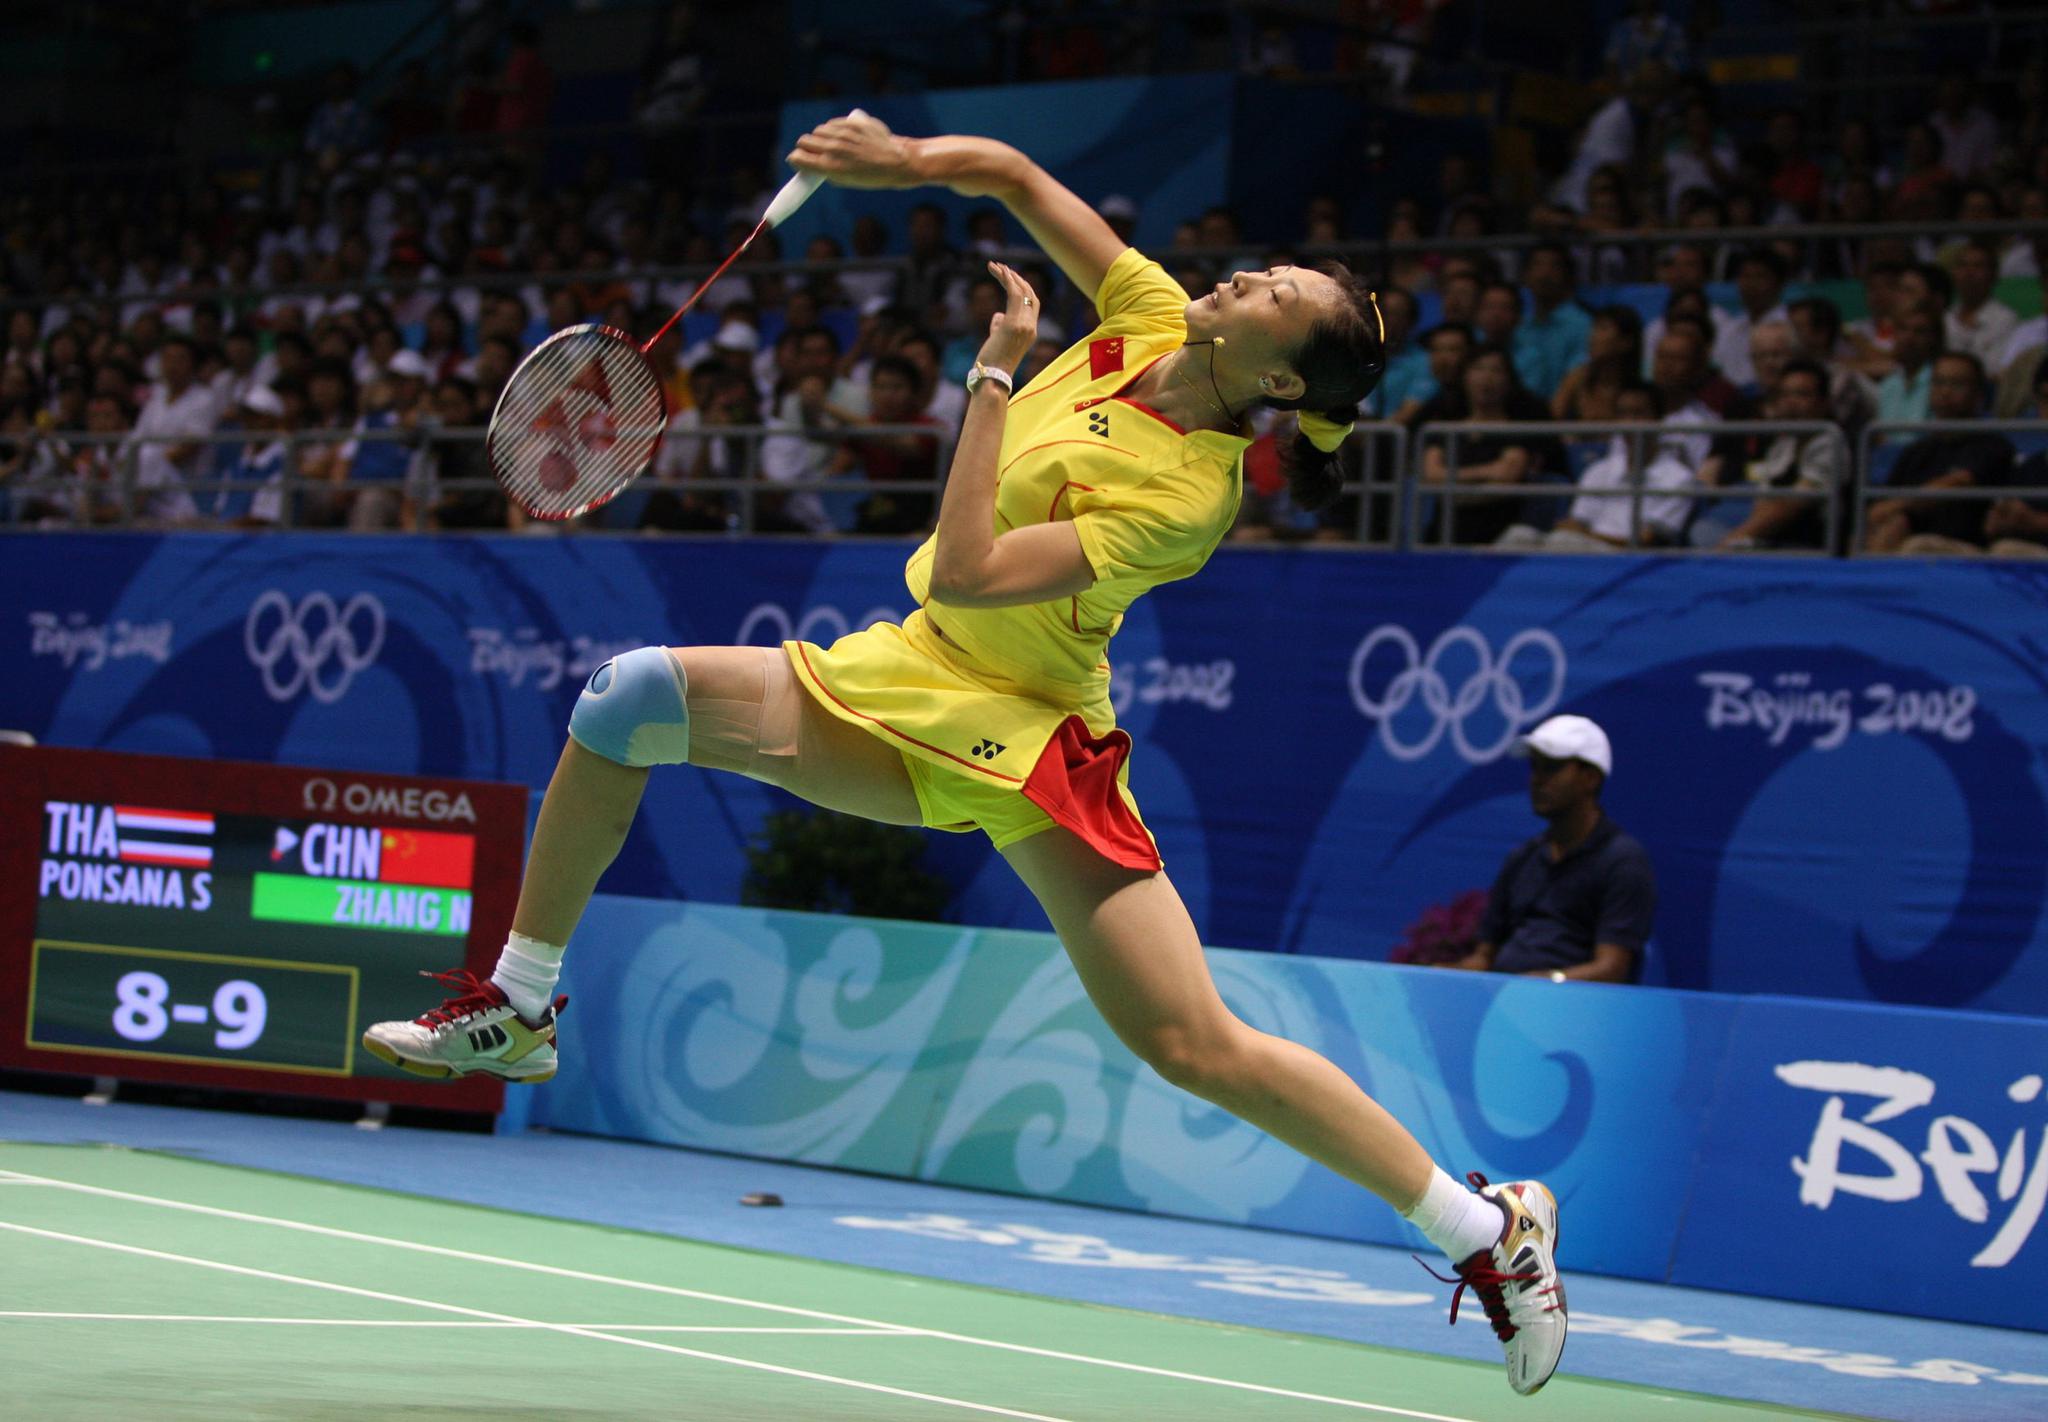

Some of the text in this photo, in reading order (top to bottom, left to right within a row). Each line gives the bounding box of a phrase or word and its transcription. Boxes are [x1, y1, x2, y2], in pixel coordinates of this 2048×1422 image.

[1697, 672, 1976, 749] Beijing 2008
[343, 784, 476, 822] OMEGA
[45, 802, 380, 880] THA CHN
[39, 861, 212, 911] PONSANA S
[333, 885, 472, 933] ZHANG N
[112, 971, 267, 1050] 8-9
